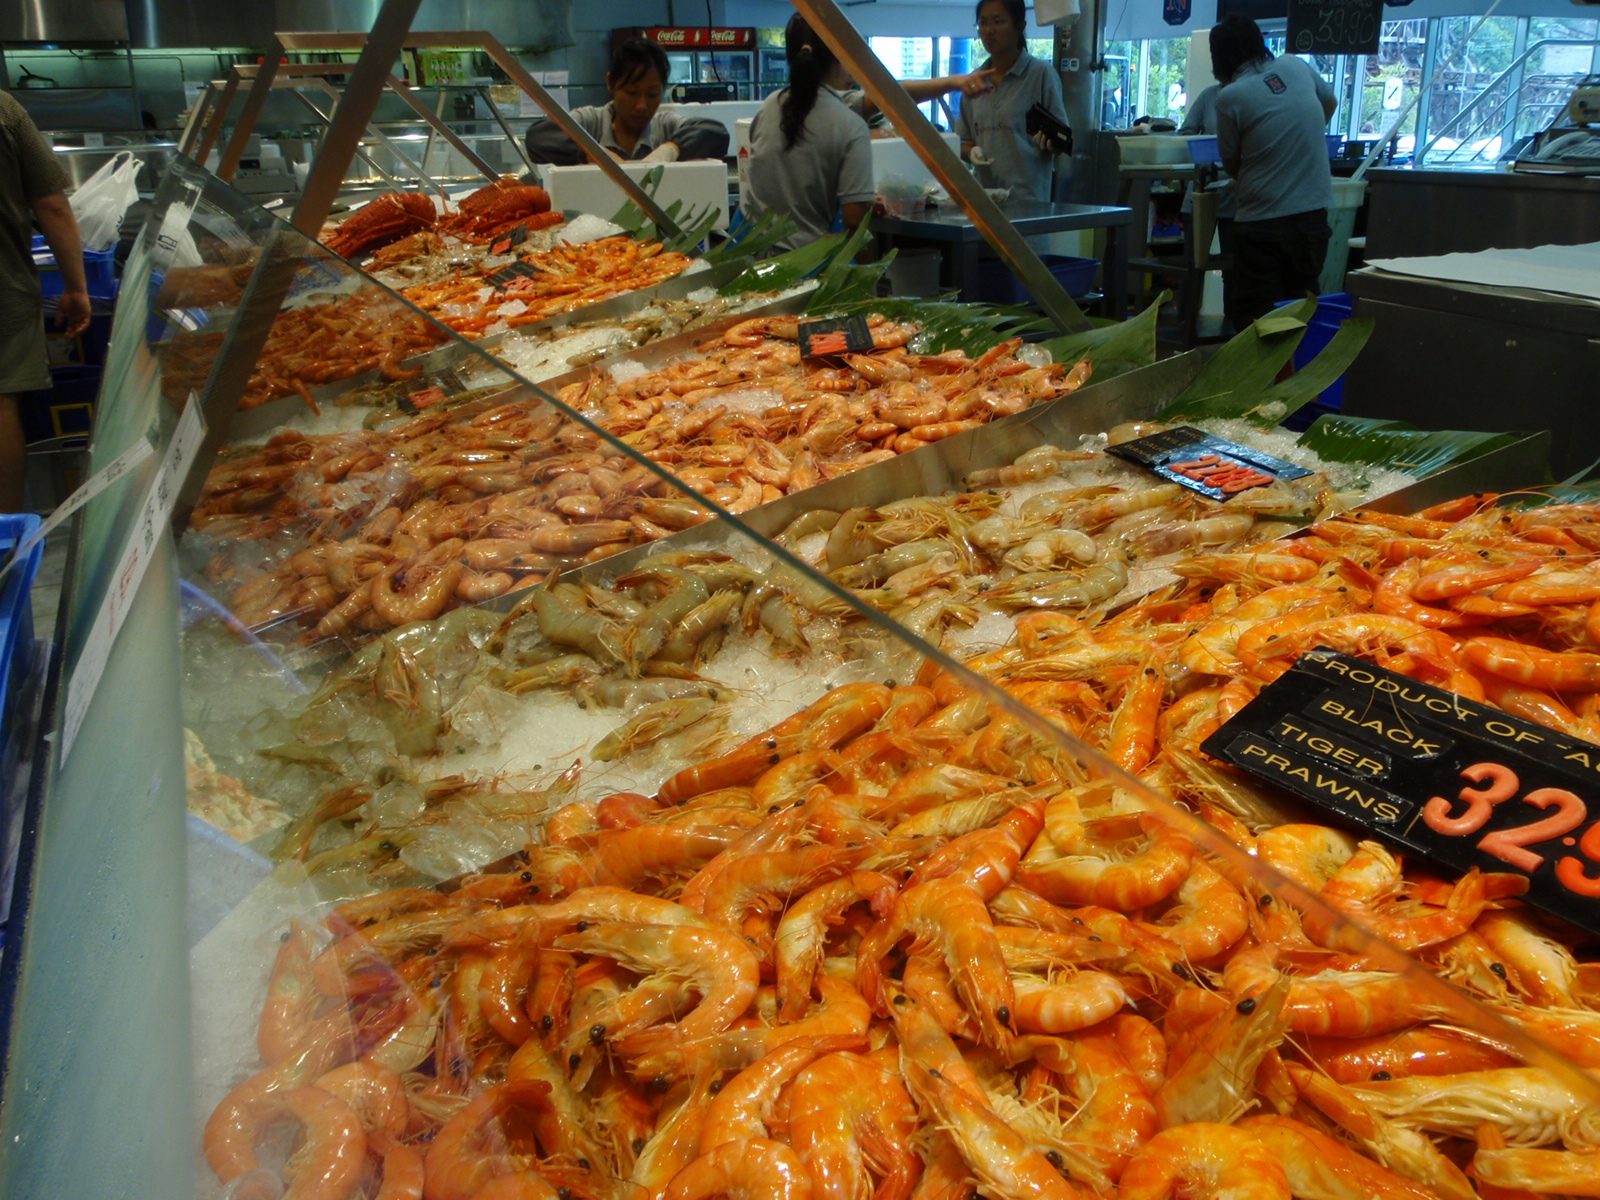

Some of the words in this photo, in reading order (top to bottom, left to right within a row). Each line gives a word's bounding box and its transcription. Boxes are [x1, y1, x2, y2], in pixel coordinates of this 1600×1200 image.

[1315, 8, 1376, 45] 39.90
[1304, 653, 1479, 721] PRODUCT
[1485, 721, 1544, 744] OF
[1279, 721, 1384, 776] TIGER
[1319, 700, 1441, 756] BLACK
[1242, 743, 1401, 821] PRAWNS
